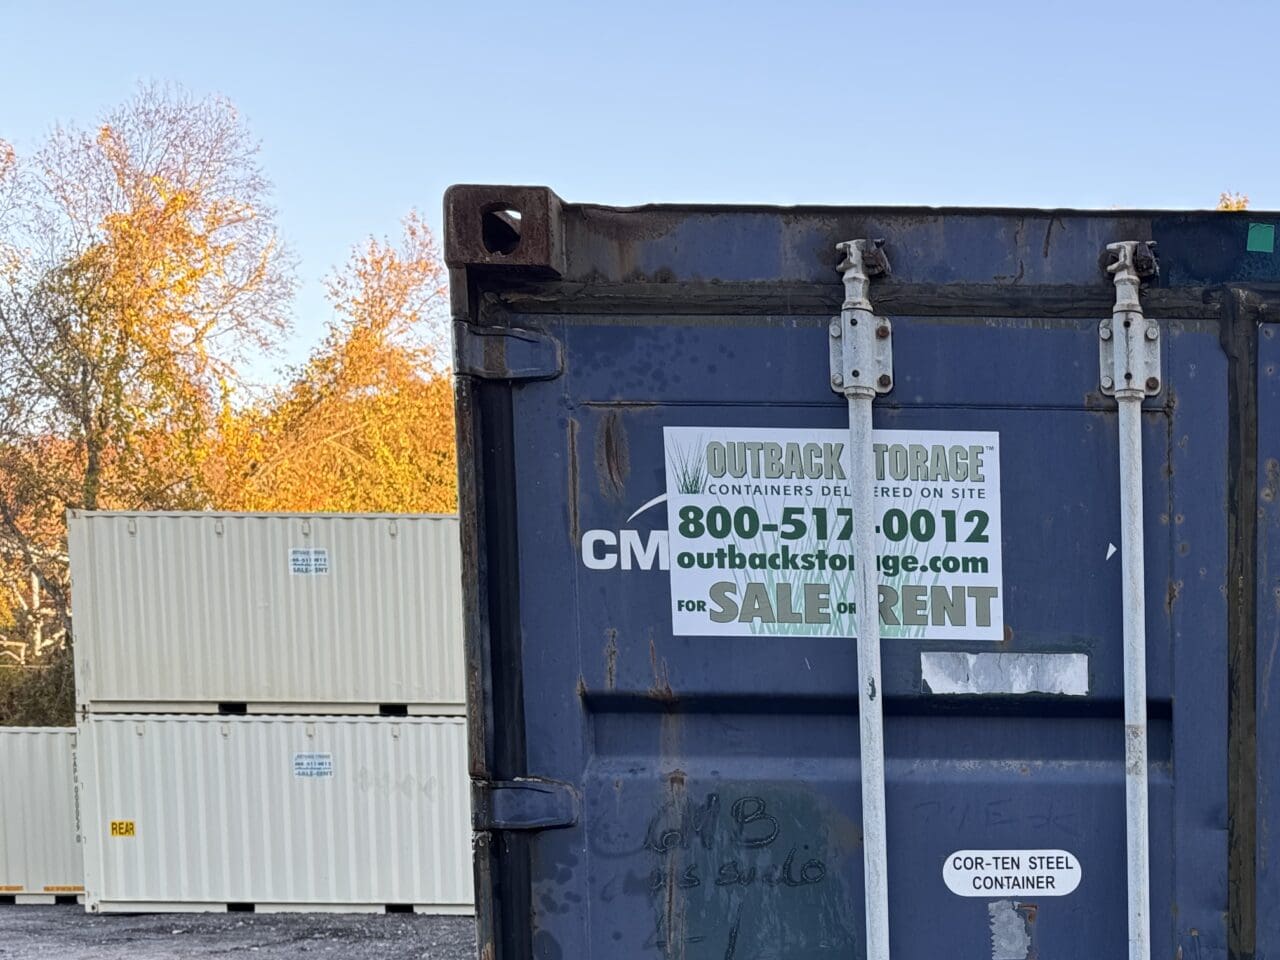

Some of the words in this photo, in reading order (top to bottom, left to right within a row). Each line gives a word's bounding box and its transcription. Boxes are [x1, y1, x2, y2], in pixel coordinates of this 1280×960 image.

[706, 441, 847, 480] OUTBACK
[872, 443, 985, 482] TORAGE
[708, 484, 813, 496] CONTAINERS
[821, 485, 912, 498] DELERED
[920, 488, 943, 498] ON
[951, 488, 986, 499] SITE
[678, 505, 989, 543] 800-5170012
[677, 599, 707, 612] FOR
[708, 581, 832, 624] SALE
[836, 602, 857, 614] OR
[877, 584, 999, 627] RENT
[111, 821, 135, 836] REAR
[953, 856, 1021, 871] COR-TEN
[1028, 856, 1074, 870] STEEL
[972, 875, 1056, 890] CONTAINER
